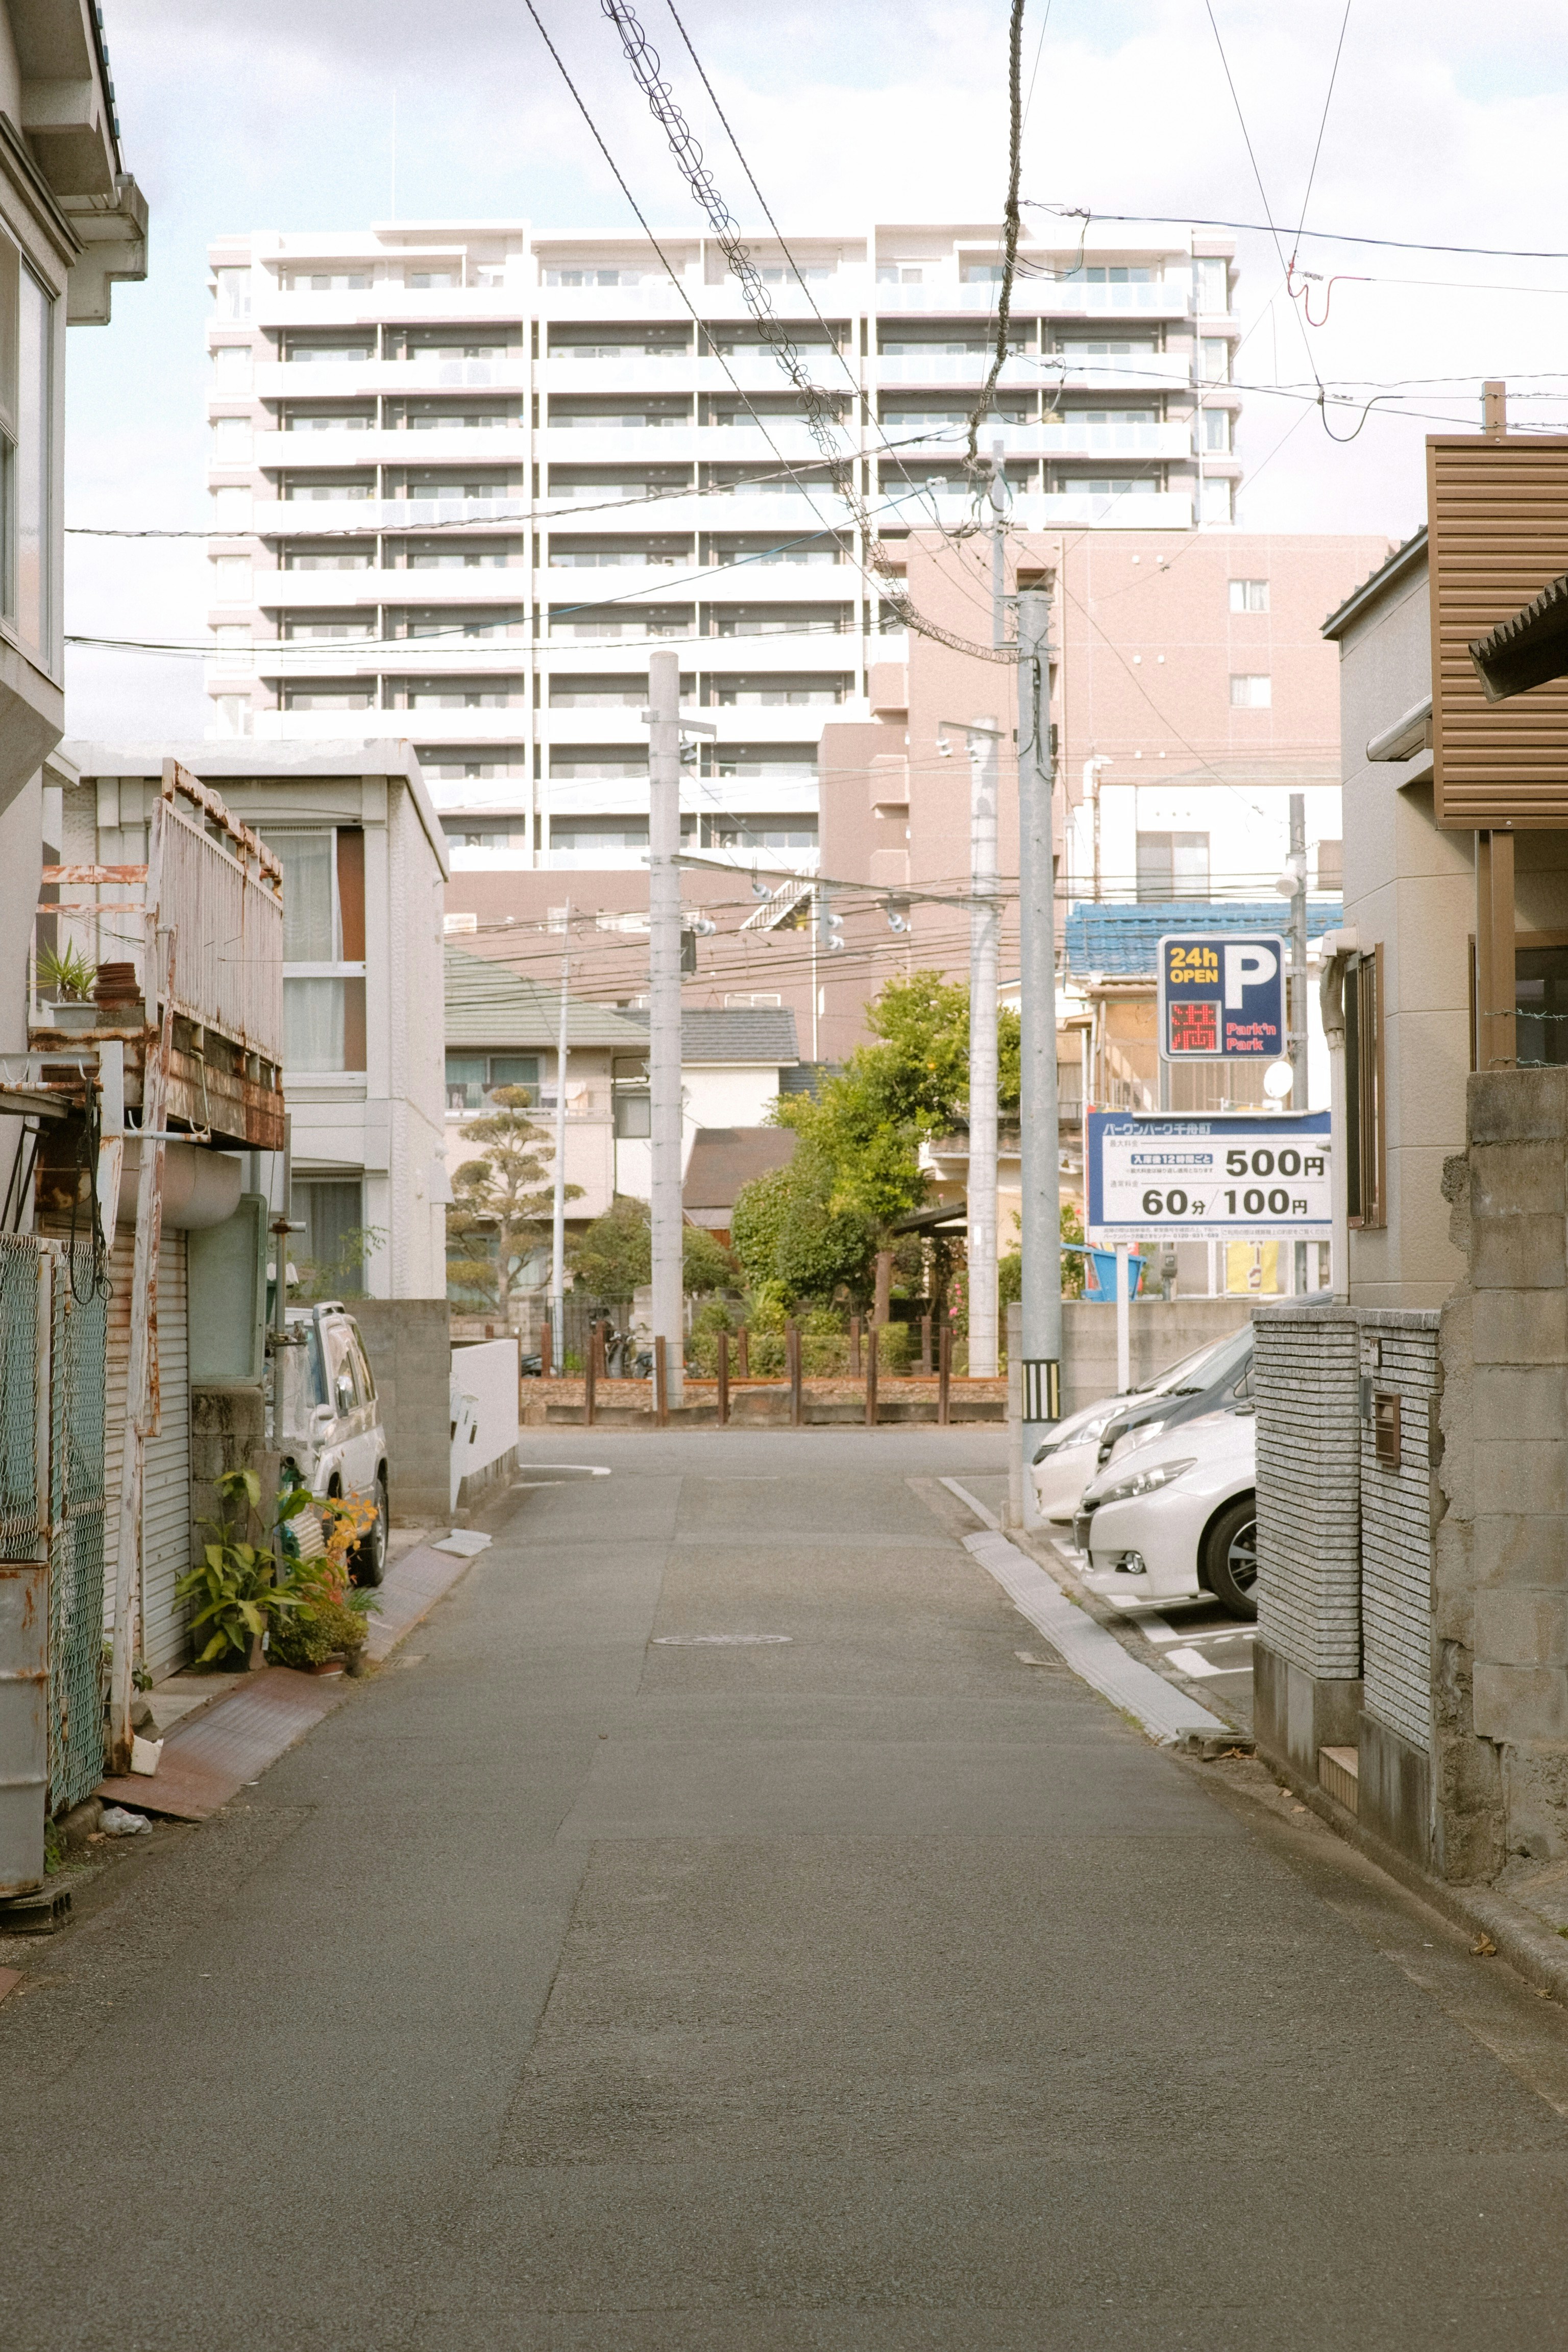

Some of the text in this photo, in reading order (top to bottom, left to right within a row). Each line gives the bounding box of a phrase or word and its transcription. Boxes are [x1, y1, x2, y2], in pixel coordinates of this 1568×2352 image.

[1170, 947, 1218, 967] 24h
[1170, 969, 1218, 983] OPEN
[1224, 945, 1277, 1009] P
[1171, 1004, 1216, 1050] 満
[1226, 1038, 1264, 1050] Park
[1226, 1149, 1324, 1177] 500円
